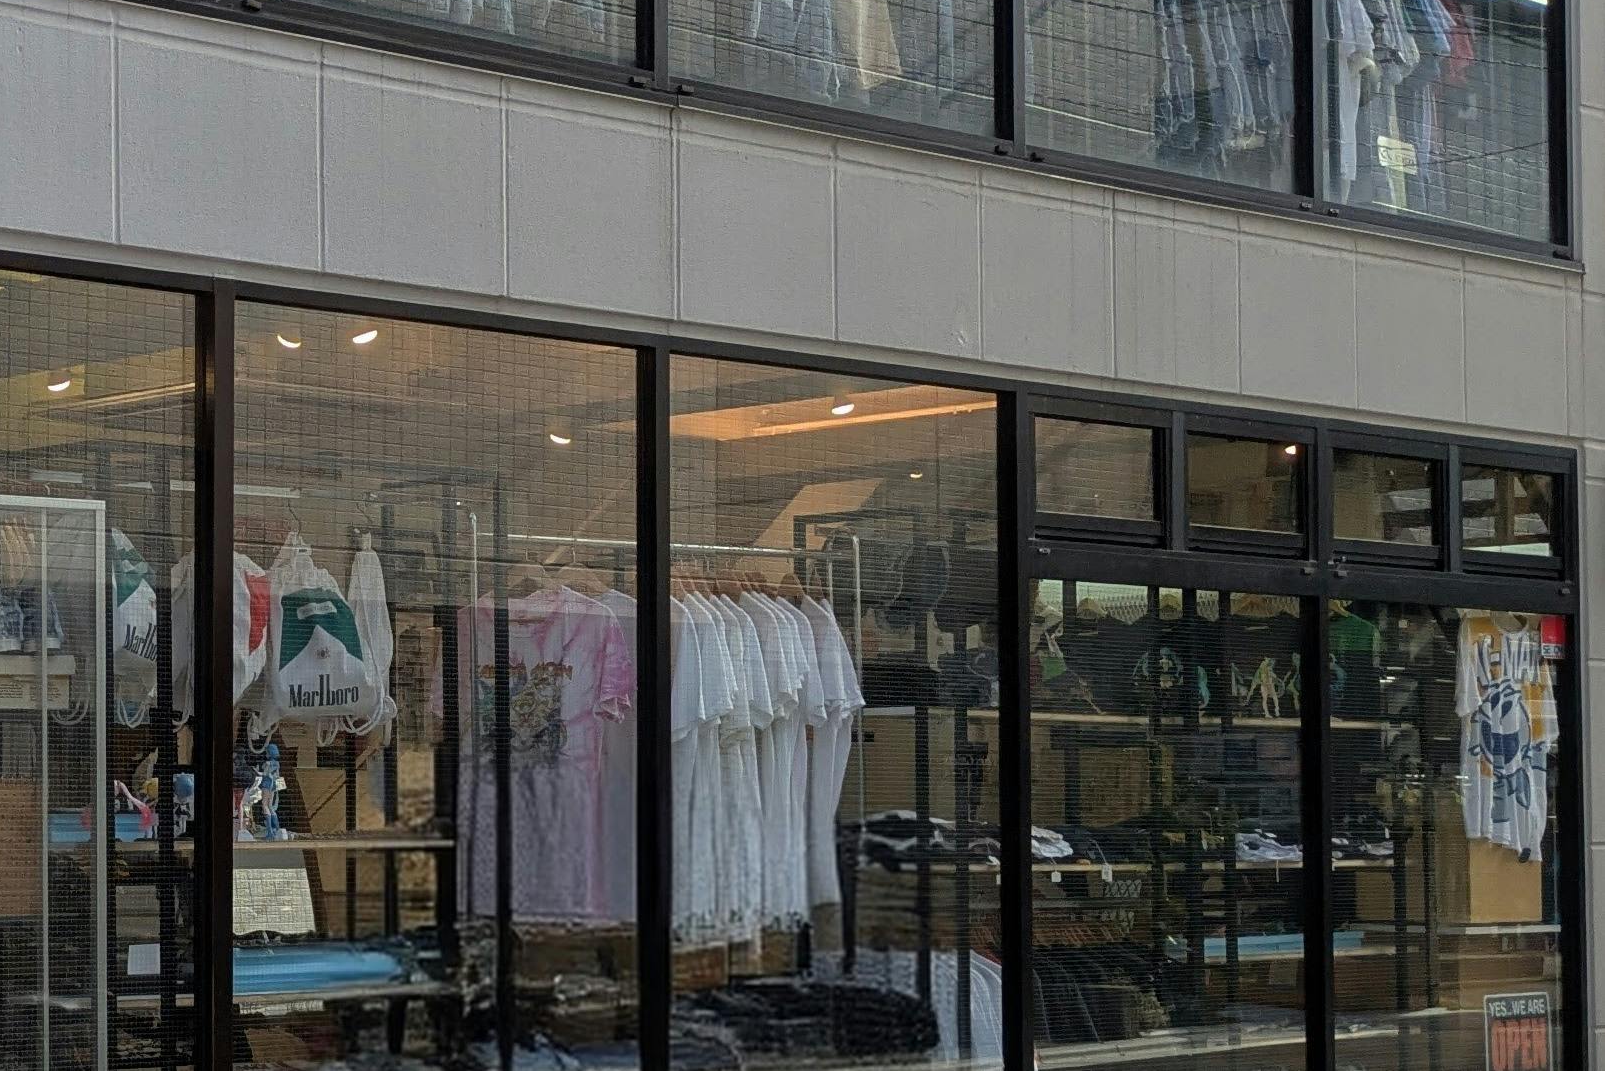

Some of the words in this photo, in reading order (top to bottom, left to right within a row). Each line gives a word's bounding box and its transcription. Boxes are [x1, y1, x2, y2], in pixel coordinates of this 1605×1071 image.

[289, 674, 359, 708] Marlboro
[1527, 998, 1545, 1014] ARE
[1491, 1018, 1547, 1071] OPEN
